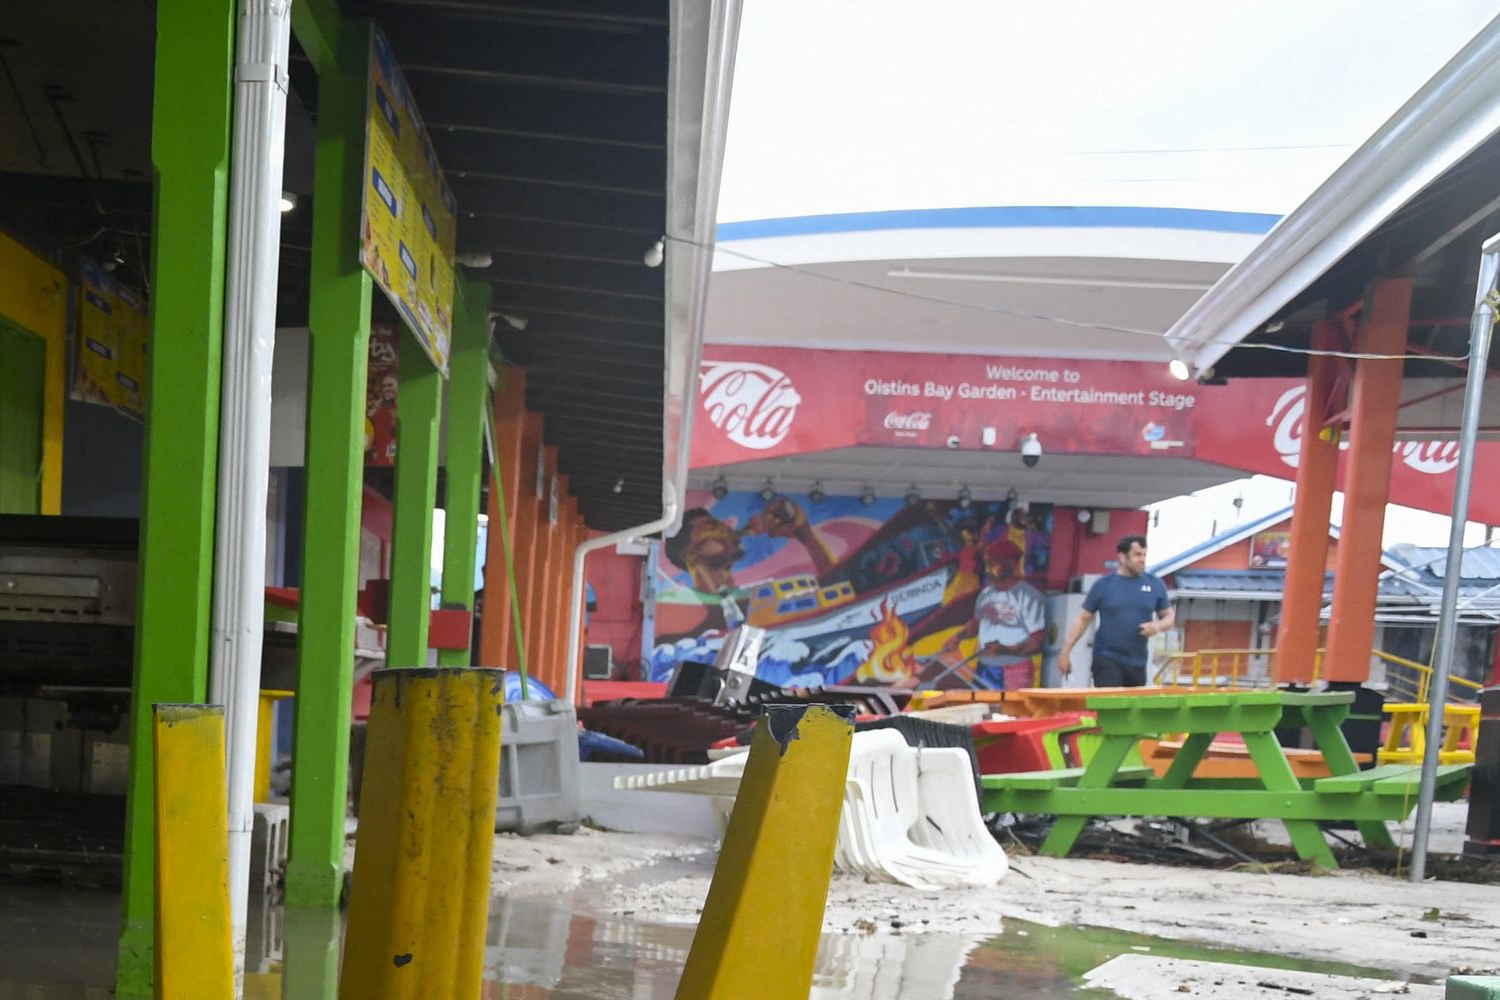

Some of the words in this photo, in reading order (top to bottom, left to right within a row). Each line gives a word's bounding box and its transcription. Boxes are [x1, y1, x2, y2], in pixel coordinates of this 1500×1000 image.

[986, 364, 1059, 383] Welcome
[1064, 368, 1080, 383] to
[864, 379, 920, 396] Oistins
[924, 381, 954, 400] Bay
[958, 383, 1017, 400] Garden
[1031, 385, 1145, 405] Entertainment
[1149, 390, 1196, 410] Stage
